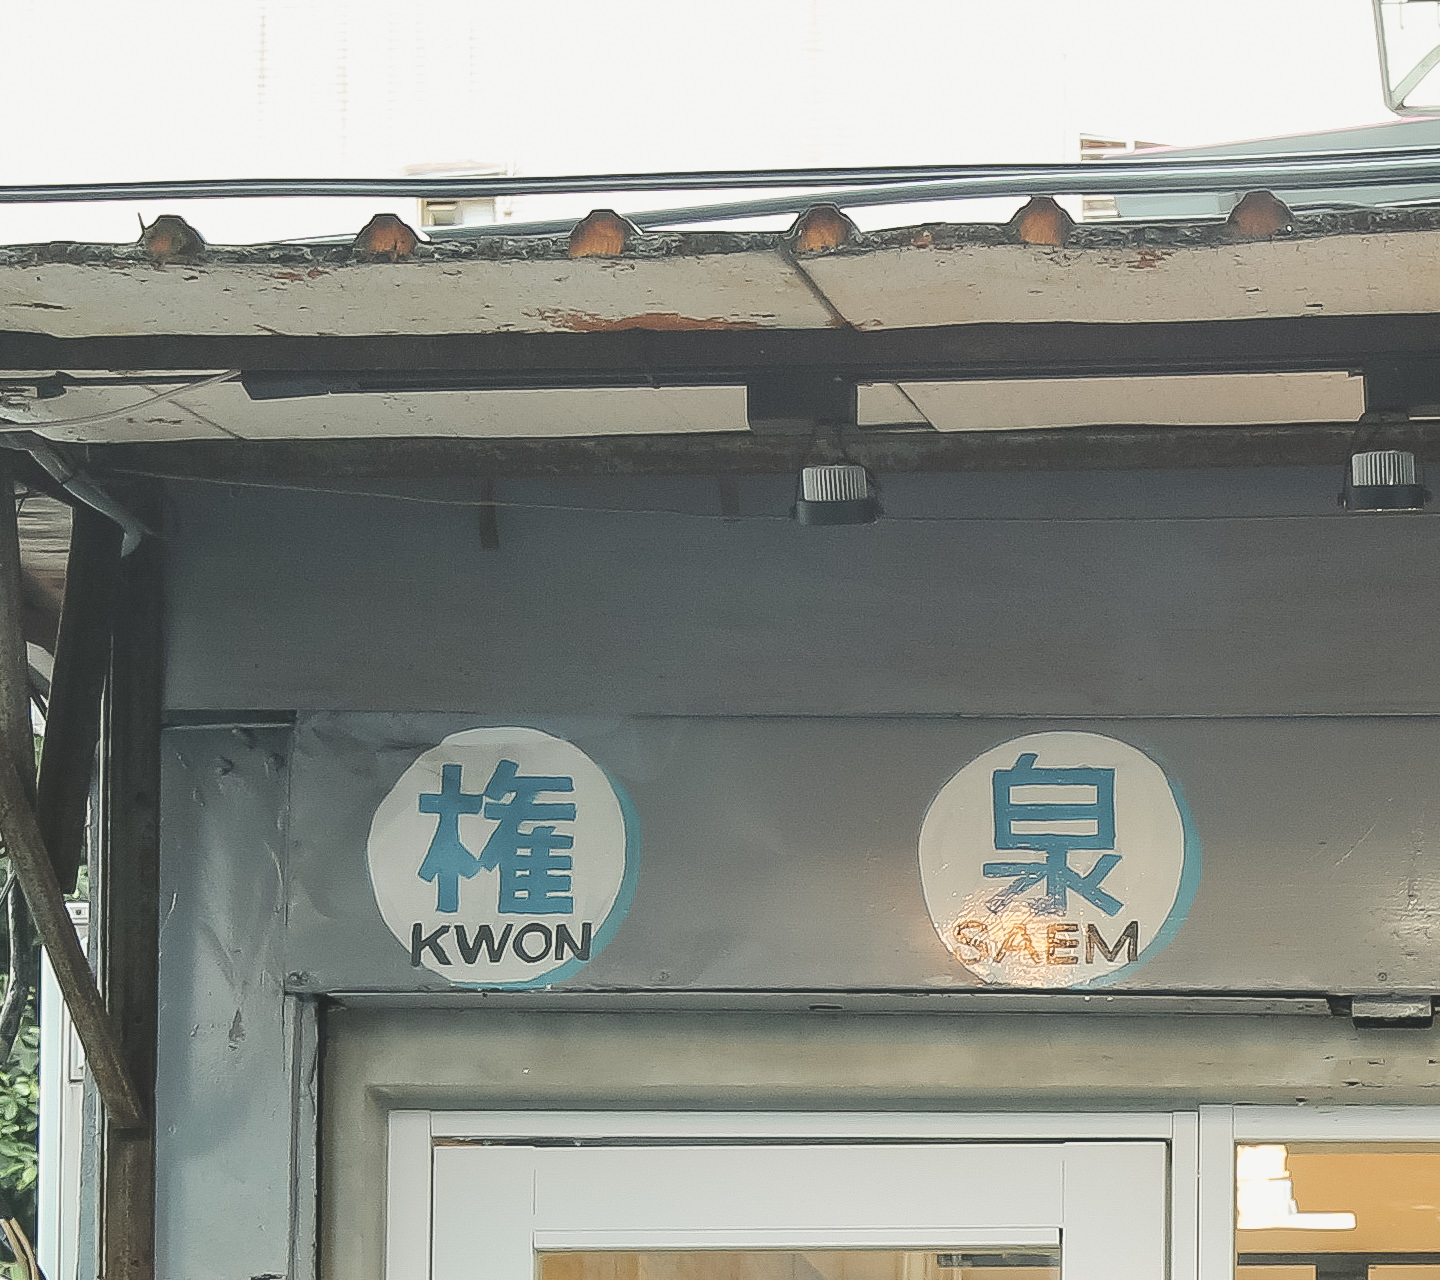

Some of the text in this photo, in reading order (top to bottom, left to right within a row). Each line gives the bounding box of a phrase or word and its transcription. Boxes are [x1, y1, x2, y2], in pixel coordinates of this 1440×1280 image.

[982, 752, 1124, 919] 泉
[409, 921, 594, 967] KWON
[952, 918, 1140, 967] SAEM
